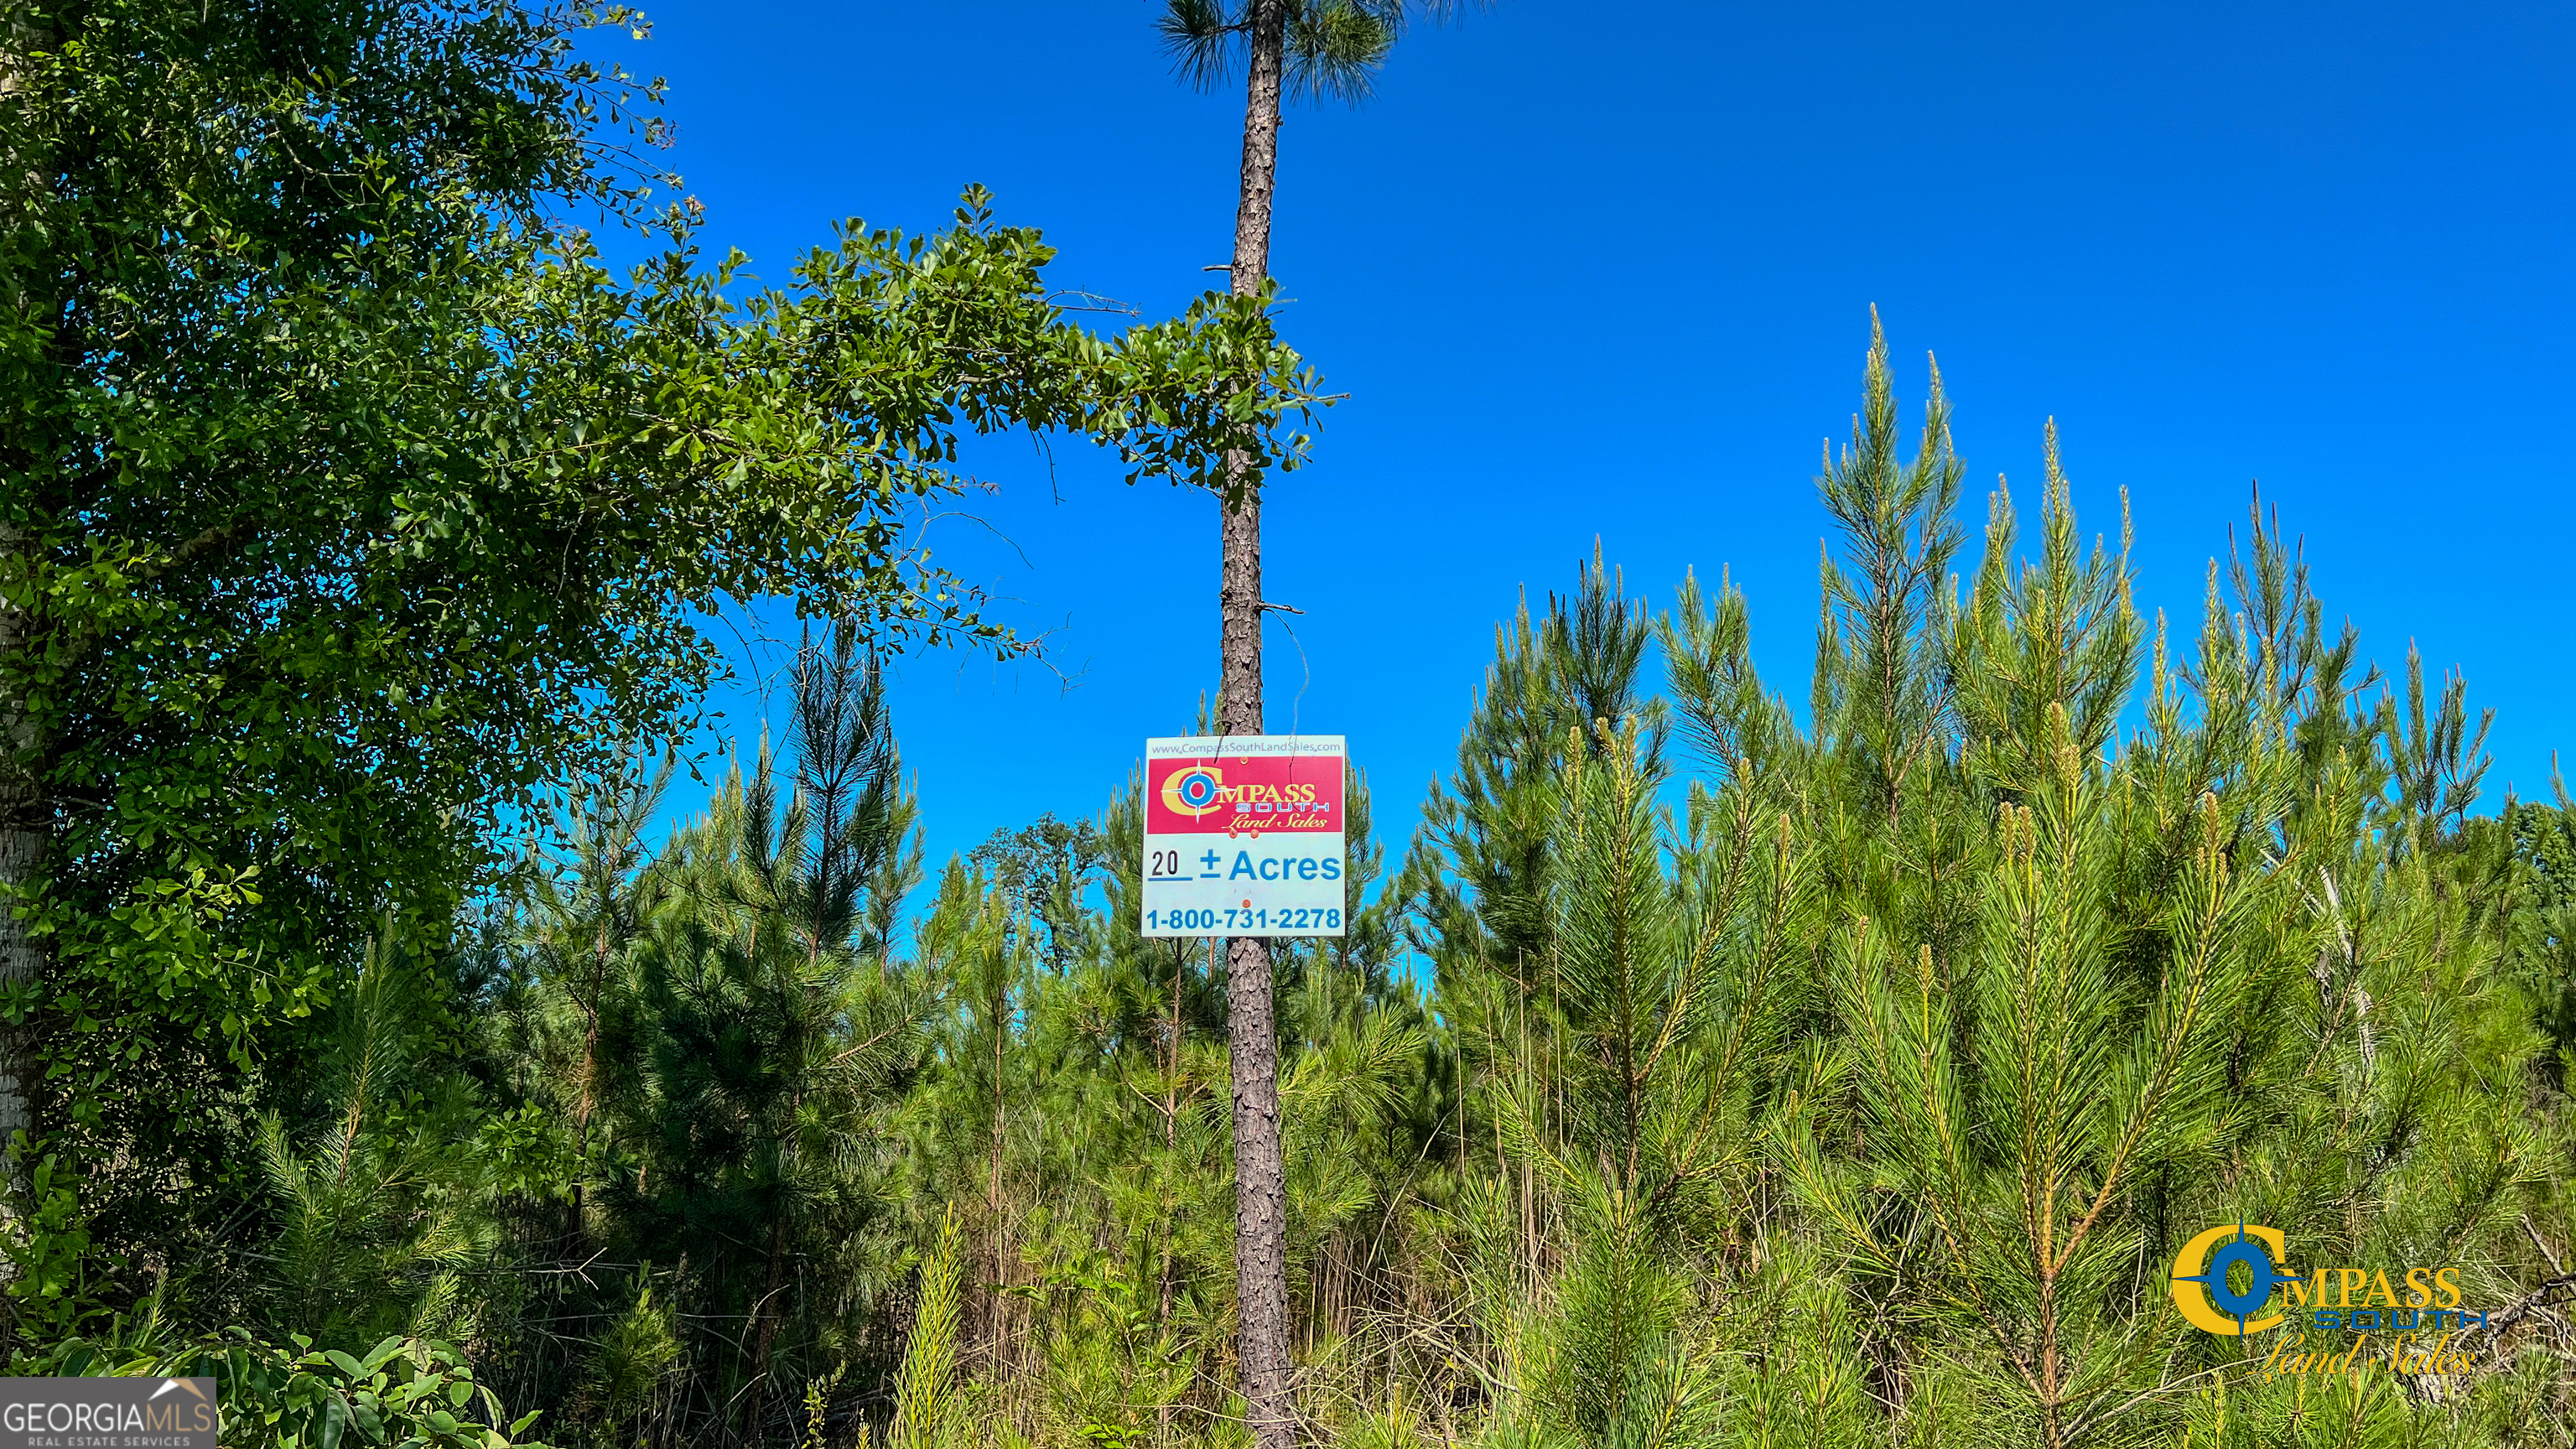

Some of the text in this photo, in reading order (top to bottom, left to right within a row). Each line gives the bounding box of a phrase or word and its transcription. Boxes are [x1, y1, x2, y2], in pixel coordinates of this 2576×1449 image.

[1151, 741, 1341, 754] www.CompassSouthLandSales.com
[1162, 766, 1317, 816] COMPASS
[1235, 802, 1330, 813] SOUTH
[1222, 813, 1328, 830] Land Sales
[1151, 849, 1178, 876] 20
[1228, 850, 1341, 880] Acres
[1146, 908, 1341, 929] 1-800-731-2278
